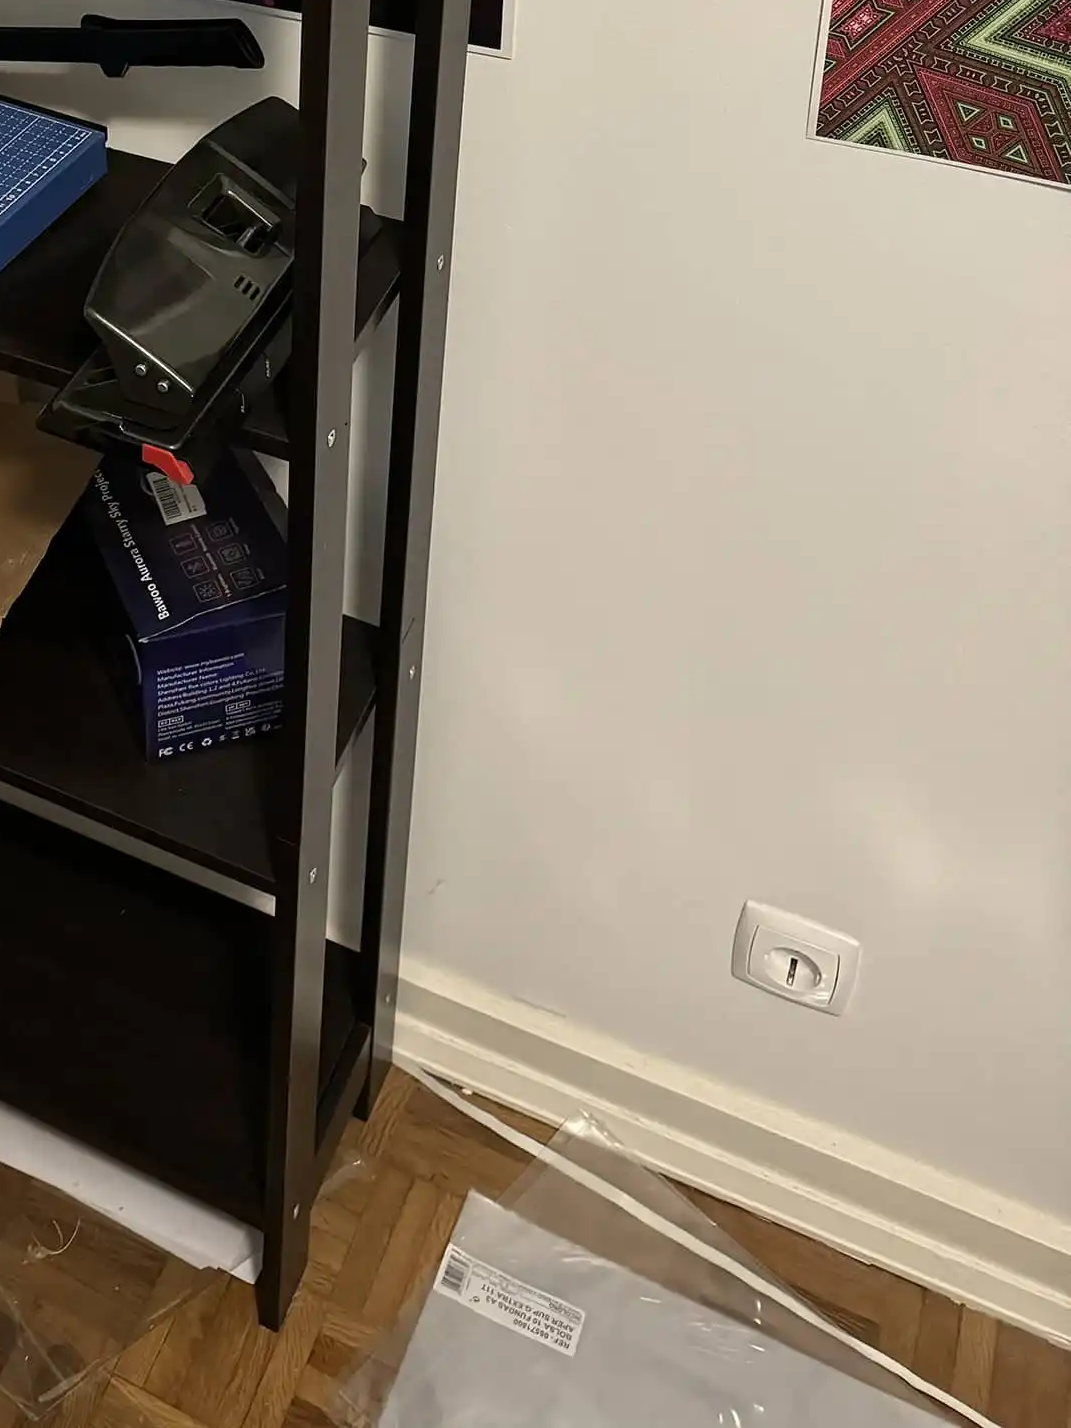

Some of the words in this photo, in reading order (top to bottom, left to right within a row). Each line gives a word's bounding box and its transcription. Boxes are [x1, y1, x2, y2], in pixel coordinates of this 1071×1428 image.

[107, 502, 121, 519] Sky
[116, 519, 135, 548] Starry
[130, 548, 153, 582] Aurora
[148, 583, 169, 620] Bawoo
[486, 1295, 497, 1305] A3
[498, 1301, 531, 1322] FUNDAS
[532, 1318, 541, 1326] 10
[544, 1323, 572, 1341] BOLSA
